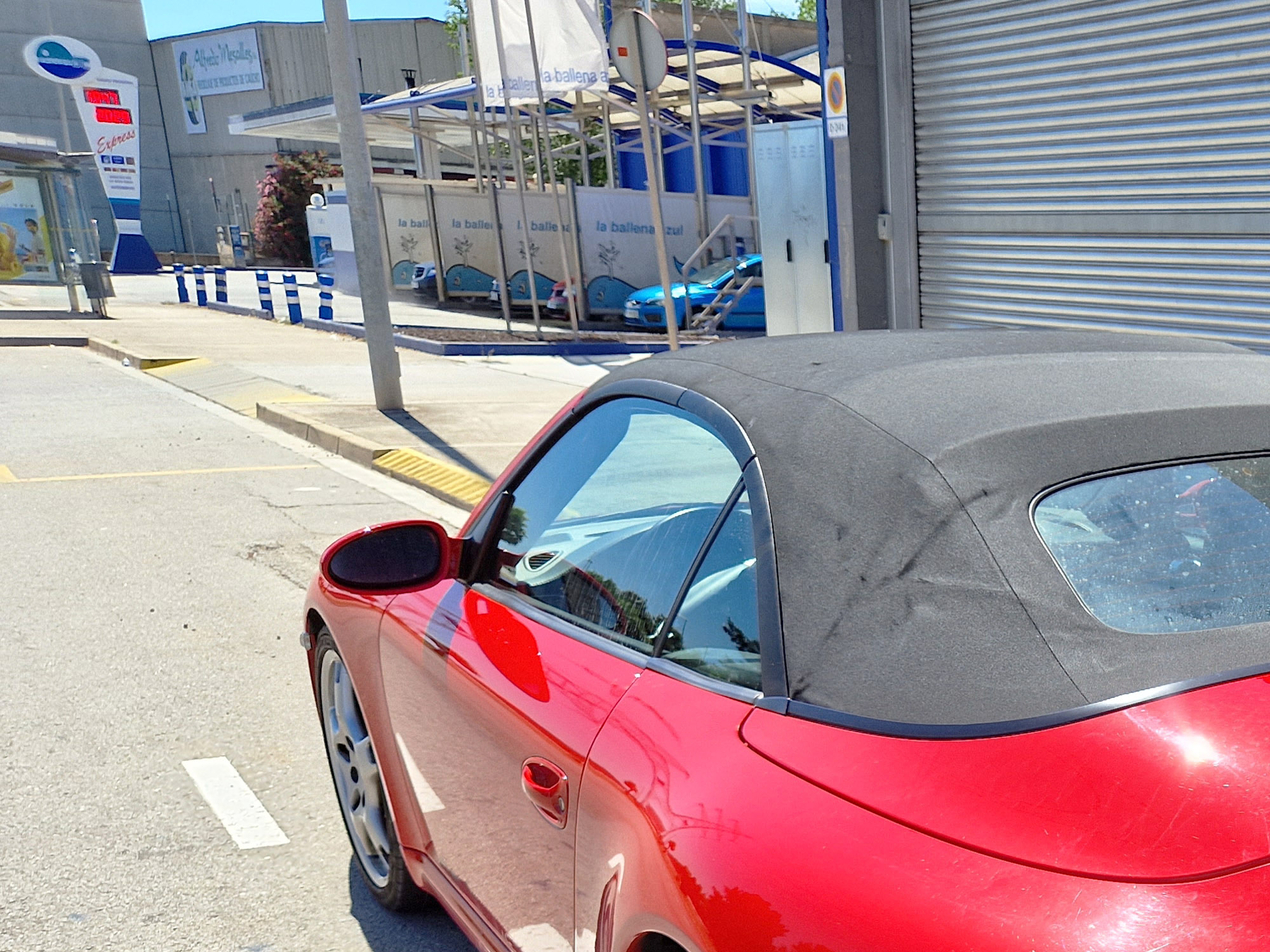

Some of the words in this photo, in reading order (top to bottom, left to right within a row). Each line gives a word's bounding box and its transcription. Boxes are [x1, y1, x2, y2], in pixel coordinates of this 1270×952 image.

[554, 67, 598, 83] ballena
[97, 130, 135, 154] Express
[398, 219, 407, 227] la
[452, 218, 461, 228] la
[597, 221, 607, 232] la
[611, 221, 655, 235] ballena
[665, 225, 684, 236] zul
